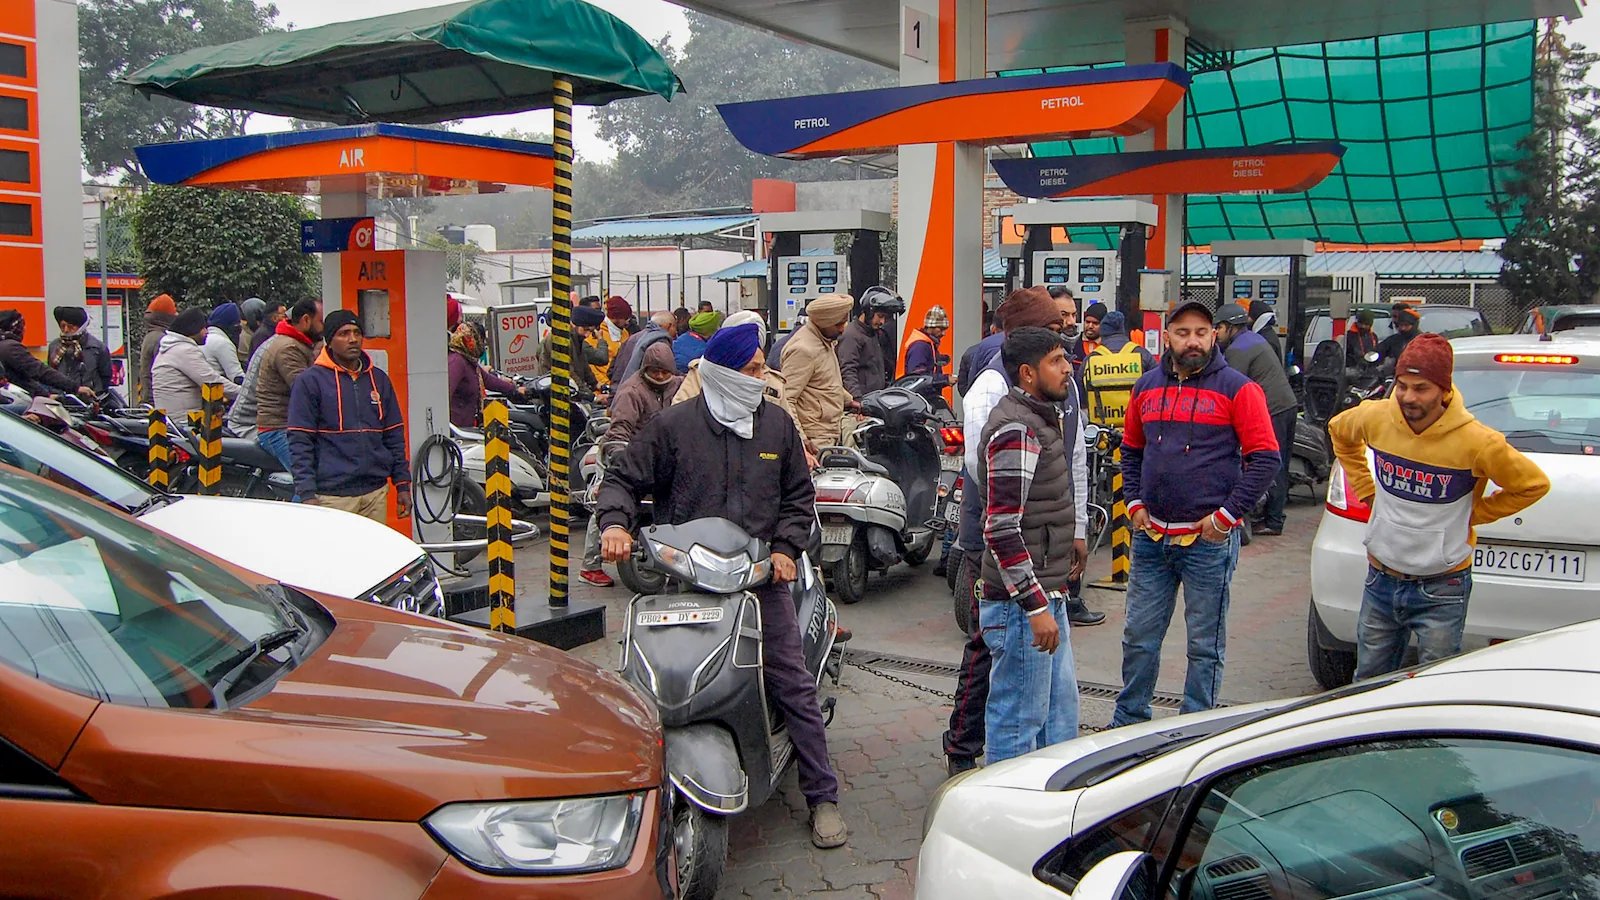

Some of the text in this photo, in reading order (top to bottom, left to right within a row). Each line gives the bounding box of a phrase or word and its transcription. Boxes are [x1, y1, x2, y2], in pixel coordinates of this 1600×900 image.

[913, 20, 920, 49] 1
[1041, 96, 1084, 110] PETROL
[794, 117, 830, 130] PETROL
[339, 148, 365, 168] AIR
[1232, 159, 1265, 168] PETROL
[1039, 168, 1069, 177] PETROL
[1233, 168, 1264, 178] DIESEL
[1039, 177, 1067, 186] DIESEL
[304, 239, 316, 247] AIR
[358, 260, 387, 281] AIR
[501, 315, 534, 331] STOP
[504, 356, 530, 365] FUELLING
[506, 364, 535, 373] PROGRESS
[1094, 362, 1140, 375] blinkit
[1375, 454, 1453, 499] TOMMY
[1474, 549, 1580, 575] B02CG7111
[668, 601, 700, 609] HONDA
[640, 614, 662, 624] PB02
[678, 613, 690, 622] DY
